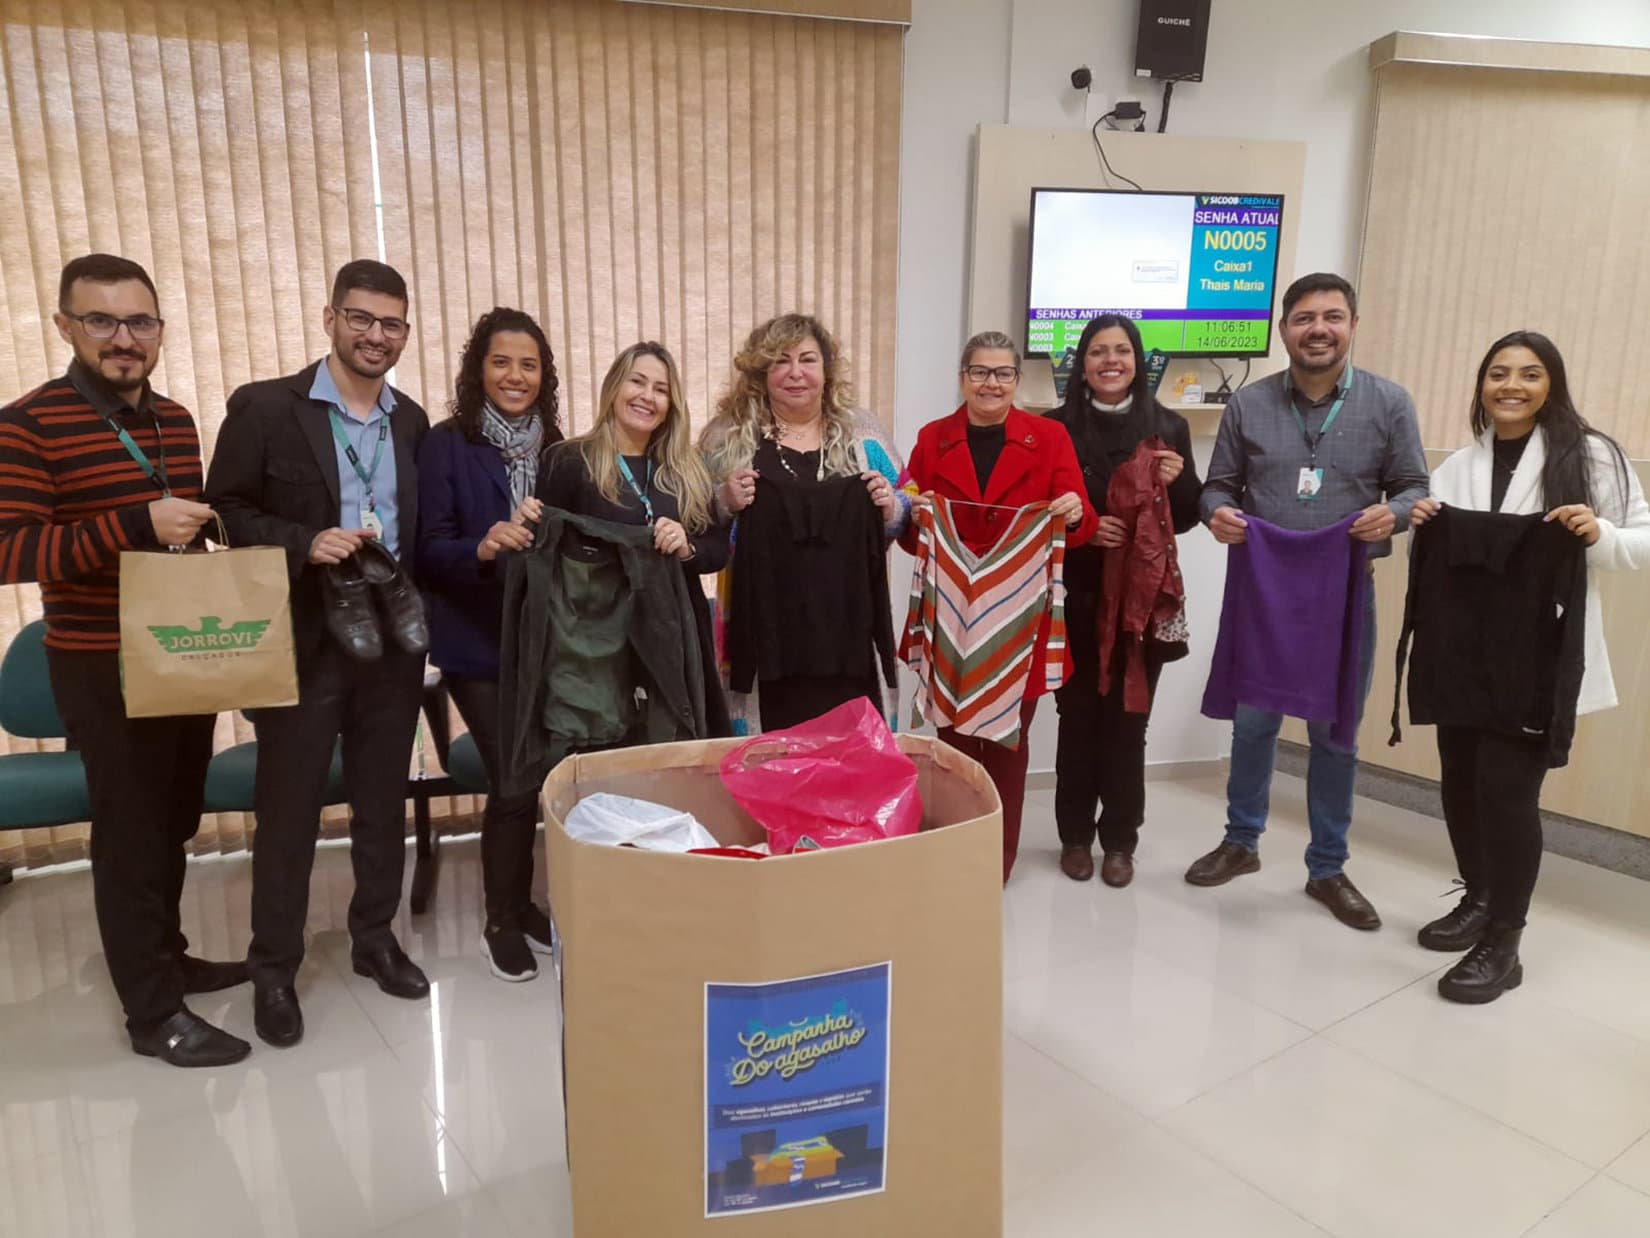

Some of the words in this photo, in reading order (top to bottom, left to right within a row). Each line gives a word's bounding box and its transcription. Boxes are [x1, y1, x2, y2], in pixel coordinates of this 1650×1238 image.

[1194, 211, 1239, 224] SENHA
[1204, 230, 1267, 251] N0005
[1214, 259, 1253, 272] Caixa1
[1199, 278, 1231, 291] Thais
[1233, 279, 1265, 291] Maria
[1036, 309, 1077, 319] SENHAS
[1205, 320, 1252, 332] 11:06:51
[1198, 336, 1258, 348] 14/06/2023
[171, 632, 252, 649] JORROVI
[738, 1013, 853, 1057] Campanha
[729, 1058, 773, 1086] Do
[774, 1027, 866, 1079] agasalho
